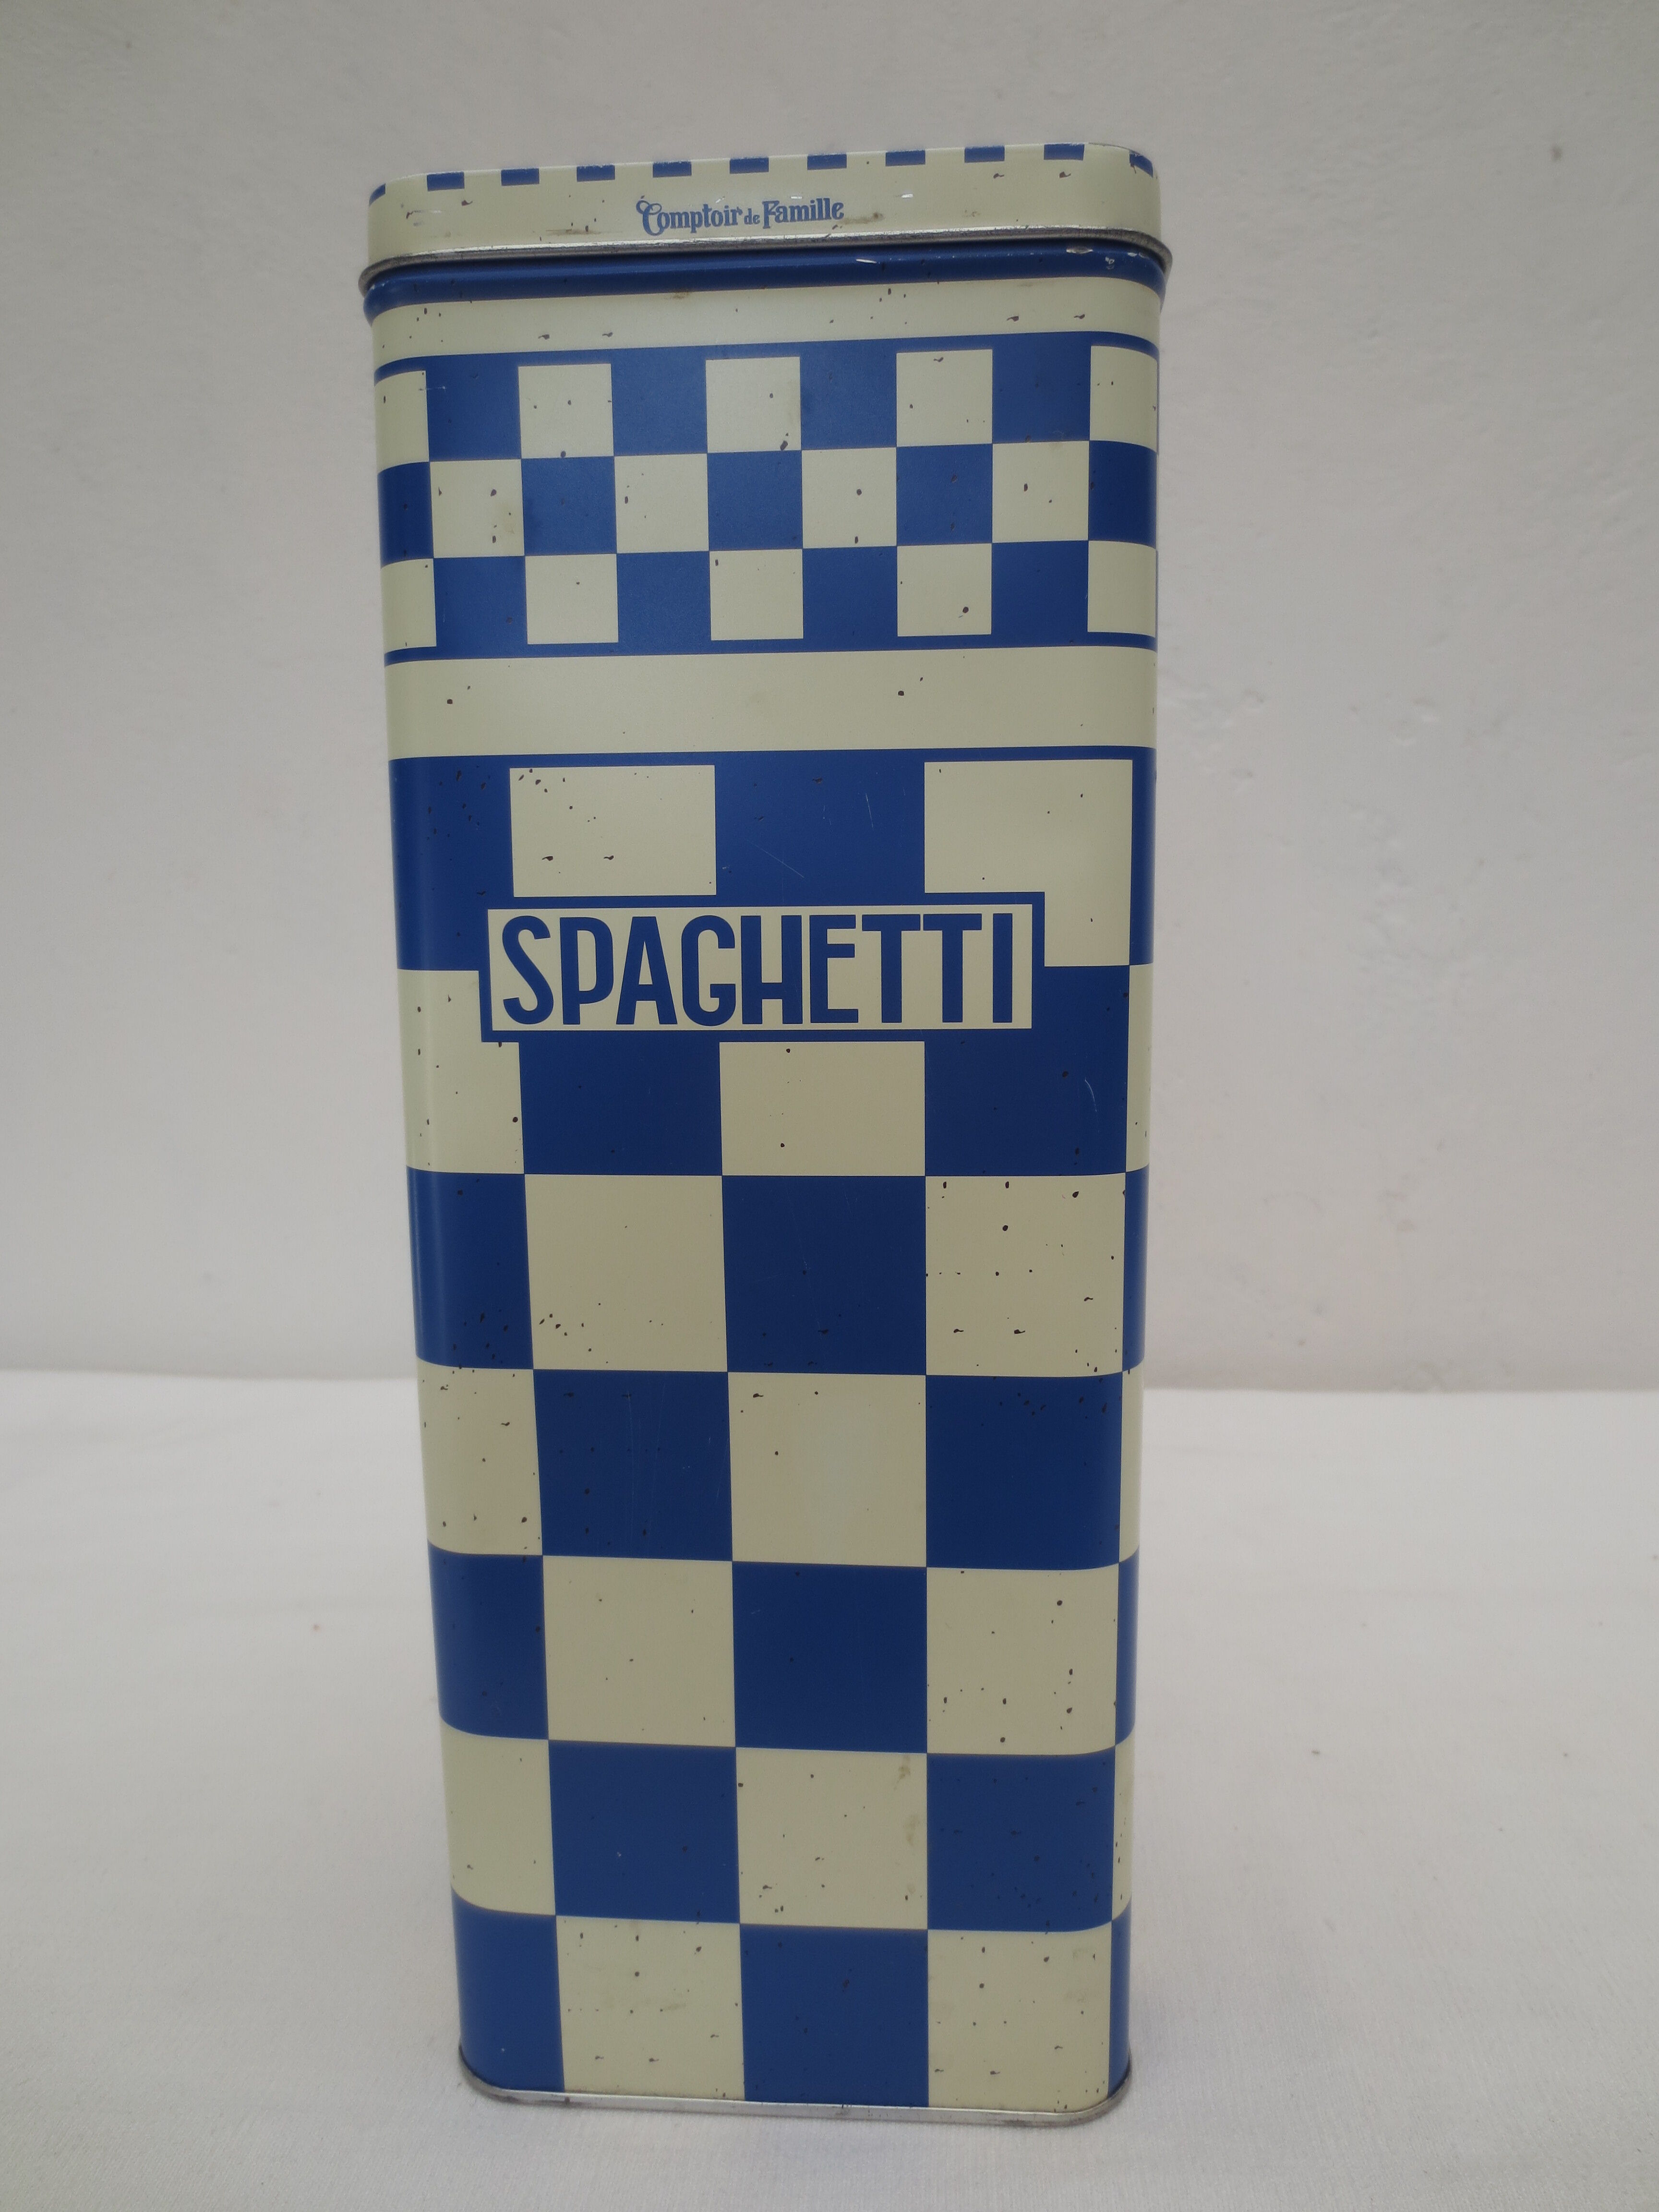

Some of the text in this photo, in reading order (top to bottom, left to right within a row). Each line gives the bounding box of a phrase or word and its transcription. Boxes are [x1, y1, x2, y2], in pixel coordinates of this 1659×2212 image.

[636, 198, 844, 236] Comptoir de Famille
[502, 913, 1013, 1027] SPAGHETTI
